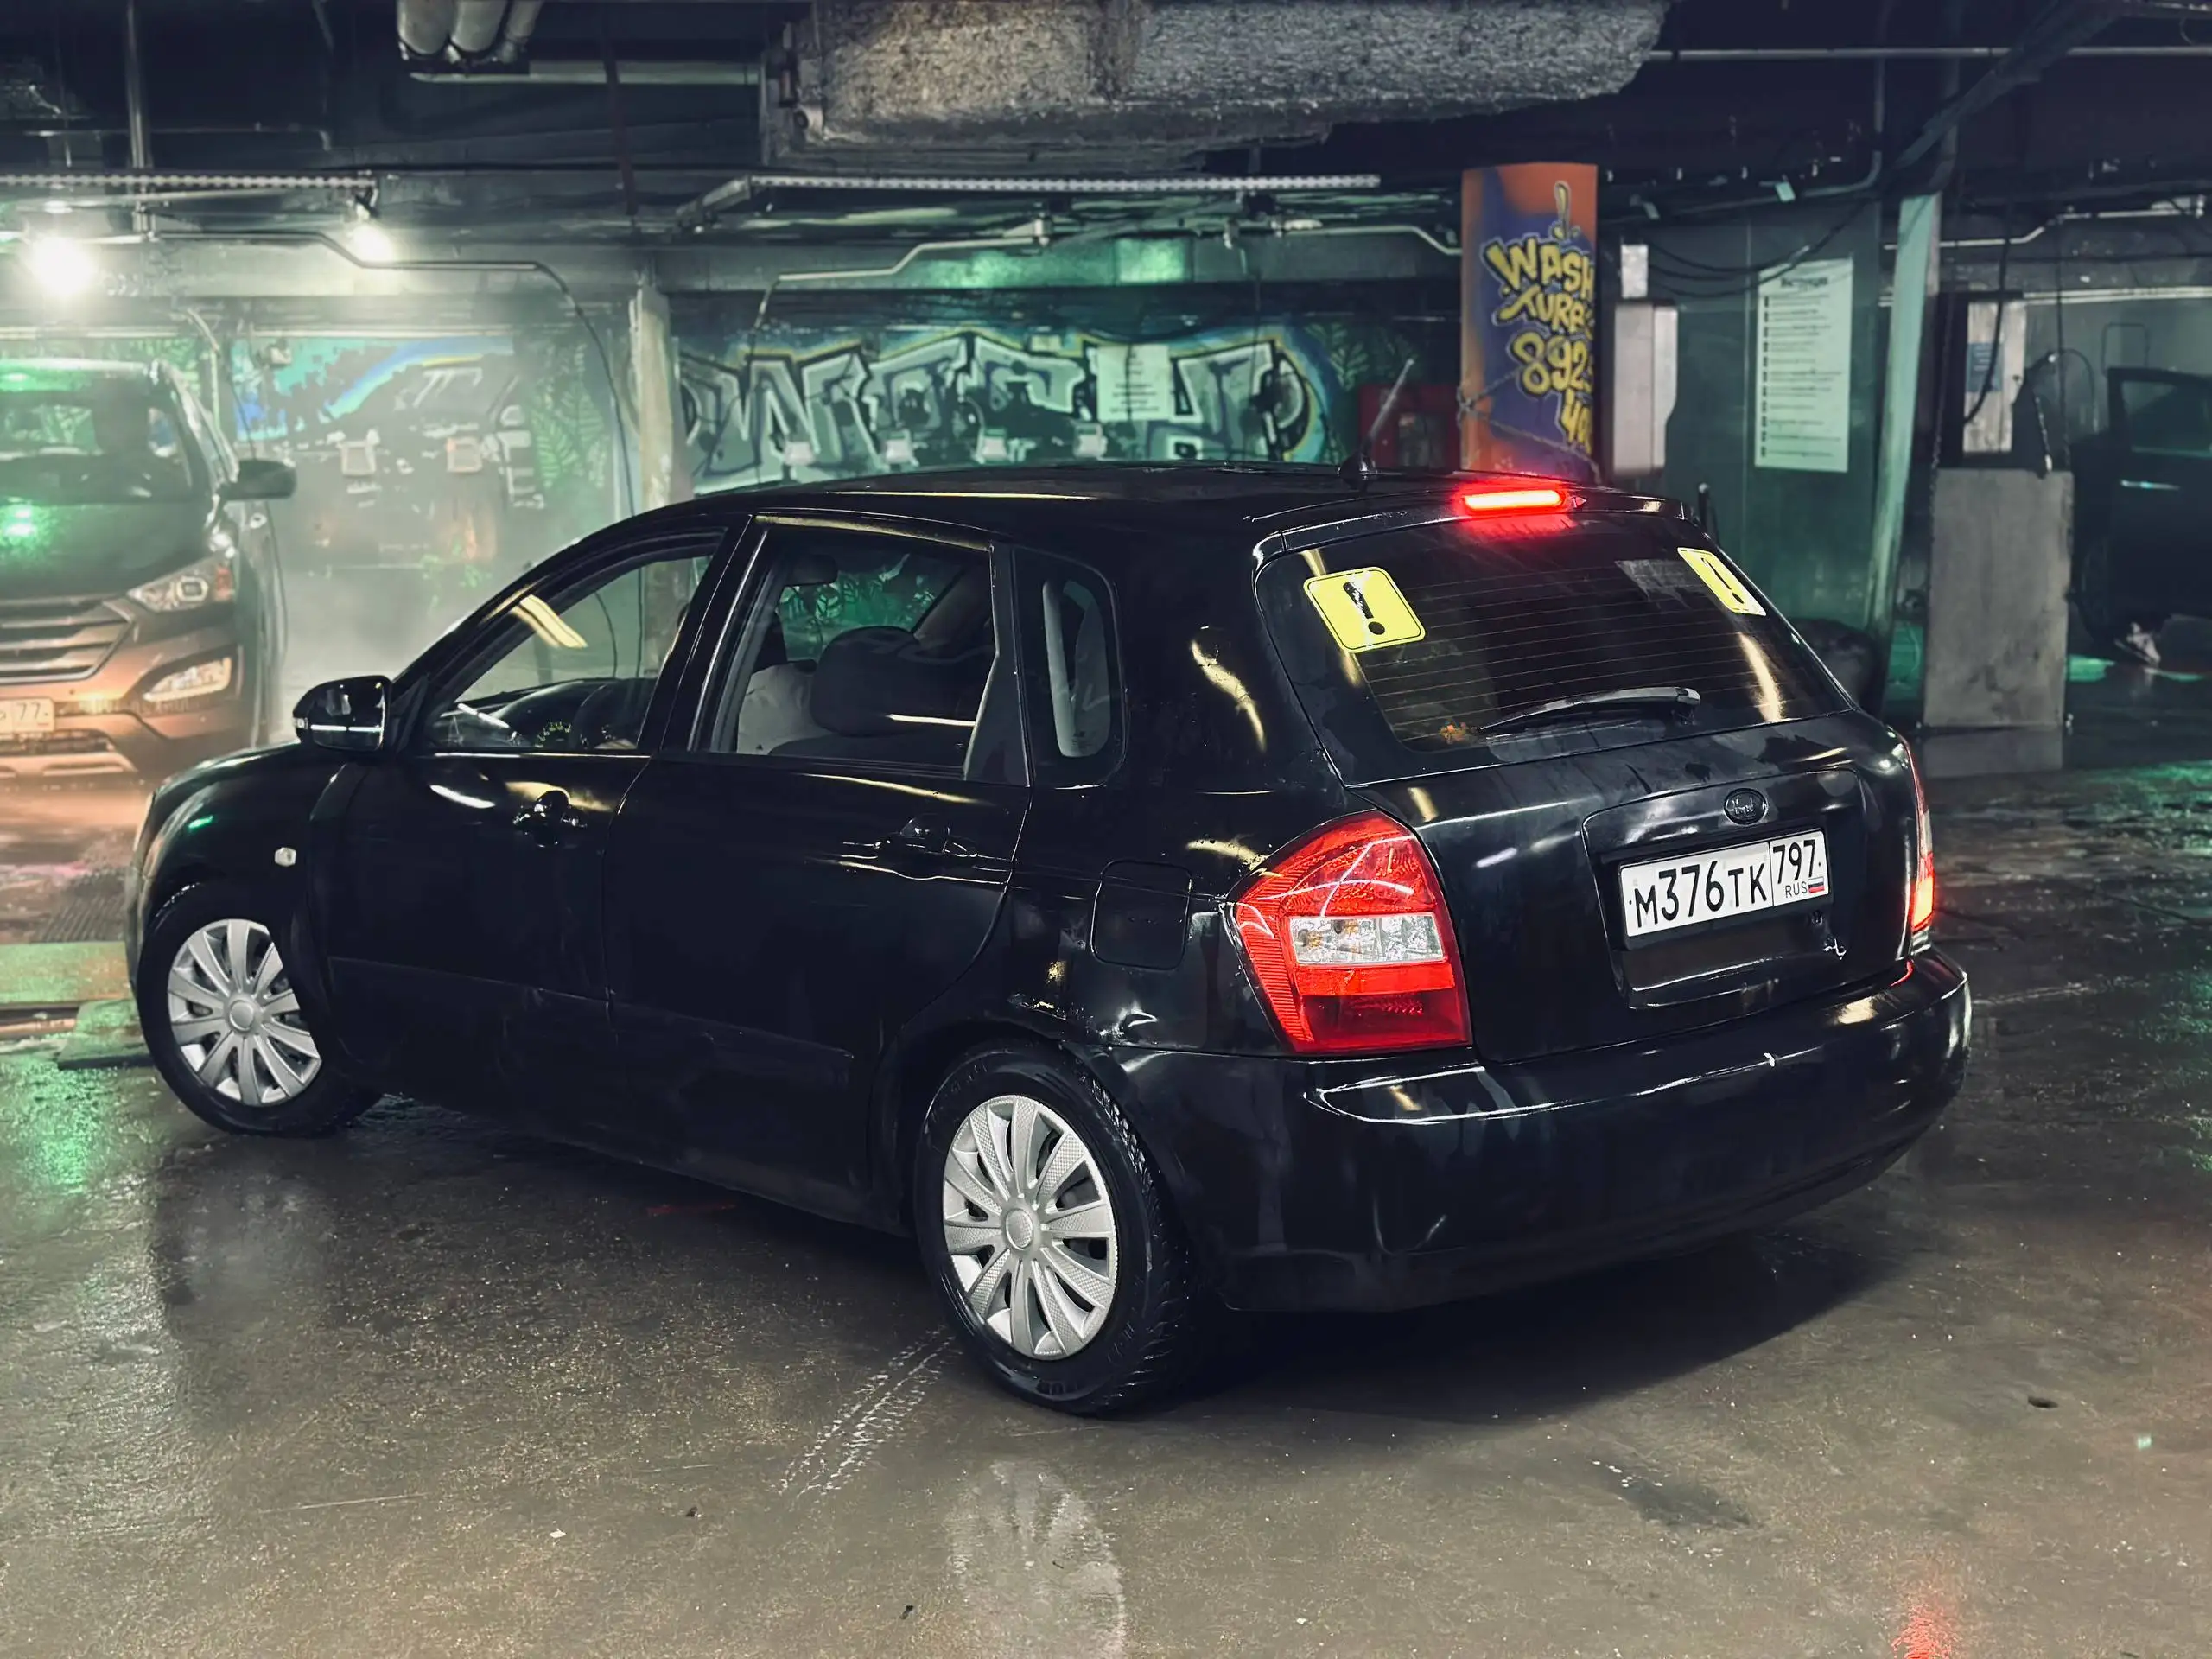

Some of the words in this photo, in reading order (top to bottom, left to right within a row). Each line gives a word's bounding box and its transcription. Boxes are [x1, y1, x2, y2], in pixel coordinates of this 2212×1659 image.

[1484, 238, 1595, 301] WASH
[1512, 332, 1593, 394] 892
[16, 701, 41, 721] 77
[1634, 860, 1767, 928] M376TK
[1773, 839, 1816, 884] 797
[1785, 881, 1808, 899] RUS
